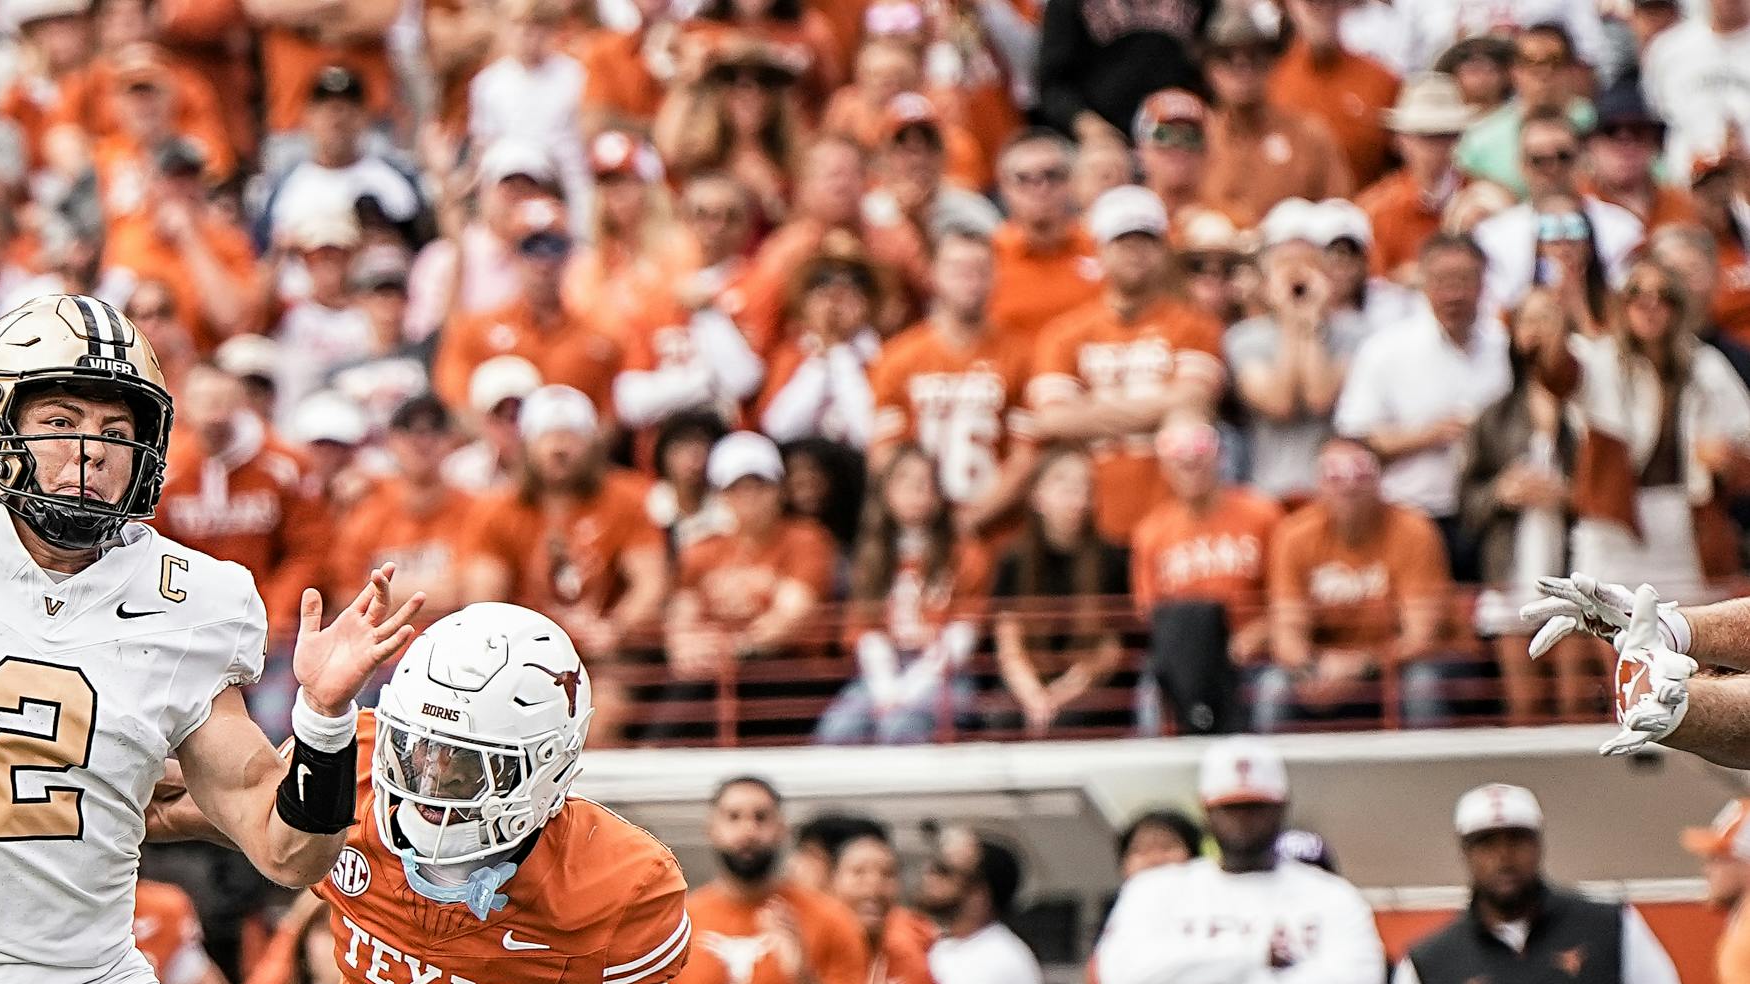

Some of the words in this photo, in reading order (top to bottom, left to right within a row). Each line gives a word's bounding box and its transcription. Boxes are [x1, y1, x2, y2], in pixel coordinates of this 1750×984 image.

[159, 554, 189, 604] C
[44, 596, 65, 617] V
[421, 702, 461, 722] HORNS
[331, 848, 371, 896] SEC
